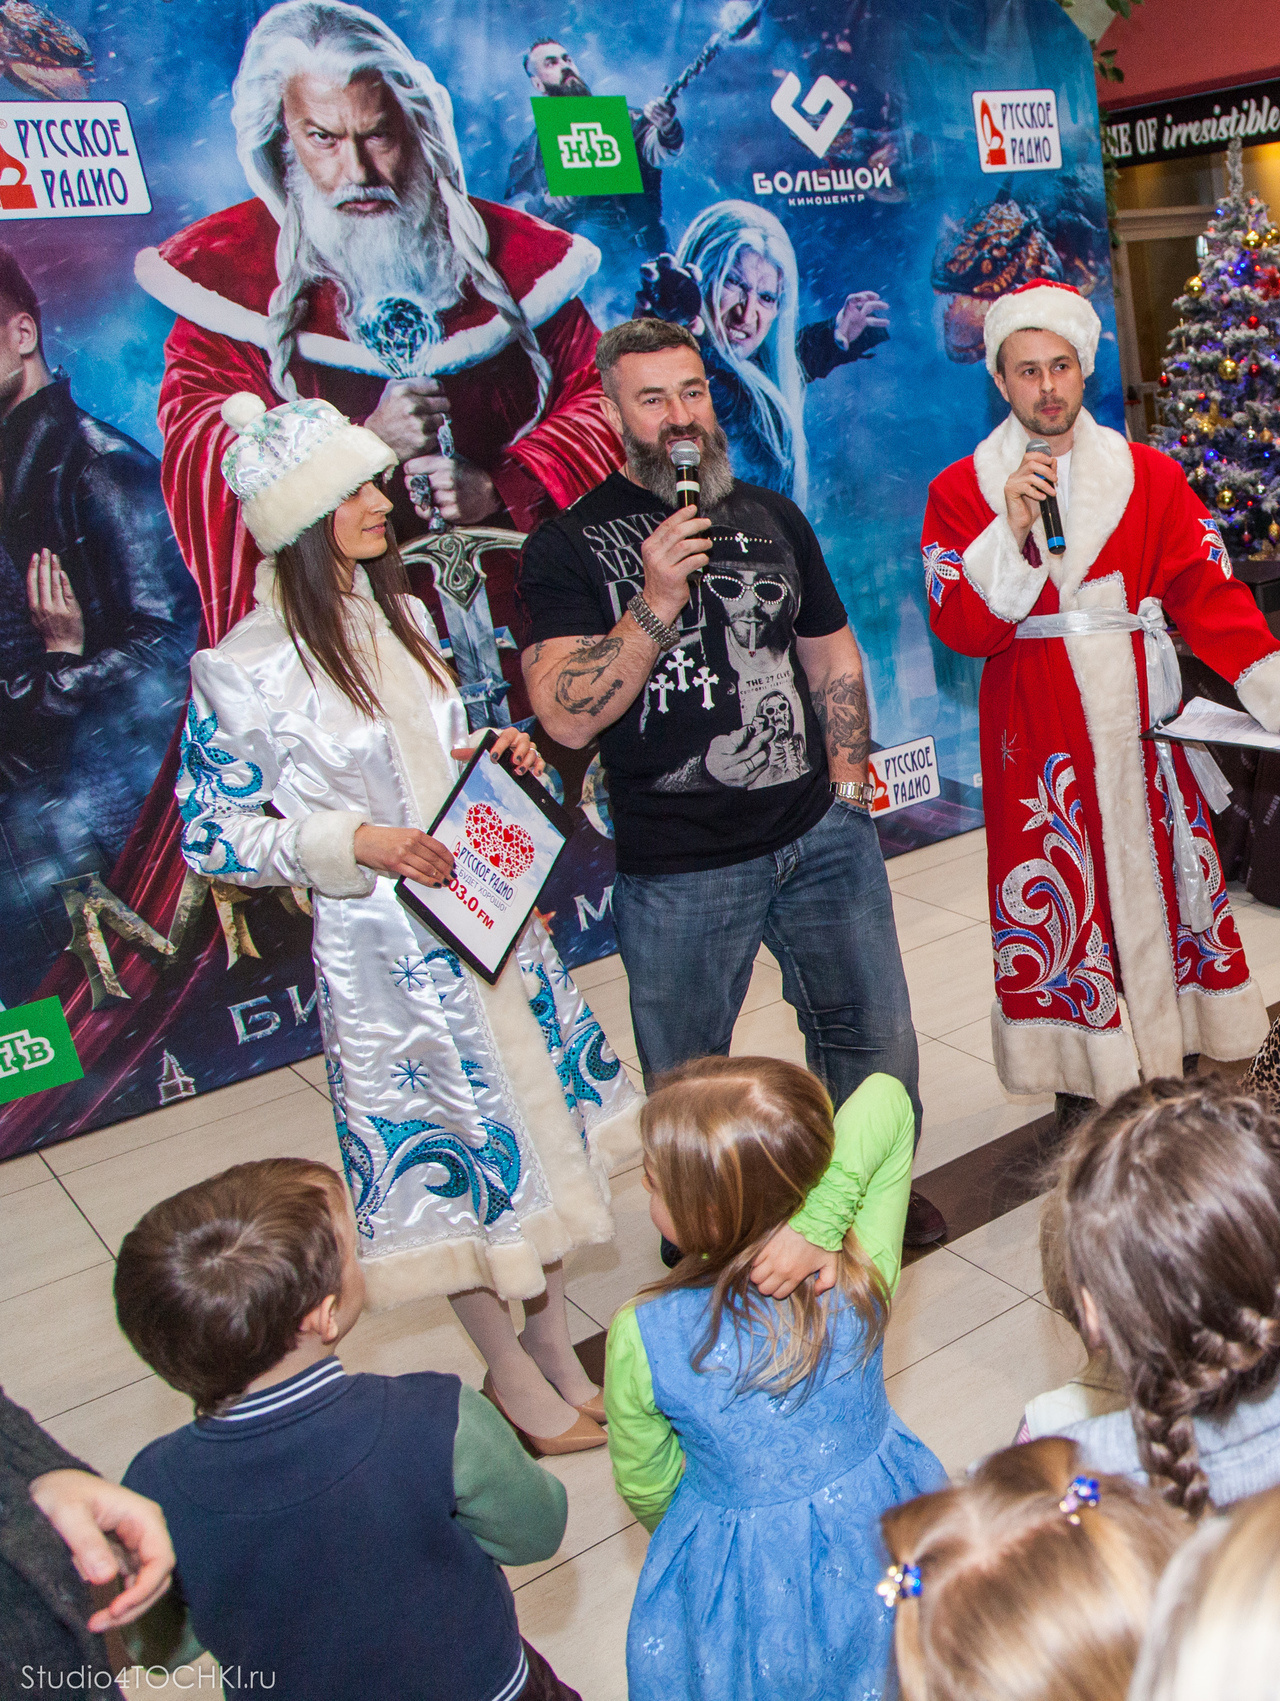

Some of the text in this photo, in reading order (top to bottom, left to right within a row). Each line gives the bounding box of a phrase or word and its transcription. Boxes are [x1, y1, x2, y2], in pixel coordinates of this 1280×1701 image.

[1000, 102, 1054, 130] РУССКОЕ
[13, 118, 130, 158] РУССКОЕ
[557, 122, 621, 169] НТВ
[1010, 136, 1052, 164] РАДИО
[1135, 117, 1158, 154] OF
[41, 167, 129, 209] РАДИО
[752, 163, 892, 195] БОЛЬШОЙ
[788, 193, 865, 206] КИНОЦЕНТР
[745, 678, 764, 687] THE
[765, 675, 774, 684] 27
[884, 746, 933, 780] РУССКОЕ
[893, 774, 931, 805] РАДИО
[458, 846, 514, 901] РУССКОЕ РАДИО
[459, 870, 507, 911] БУДЕТ ХОРОШО!
[448, 878, 495, 930] 03.0 FM
